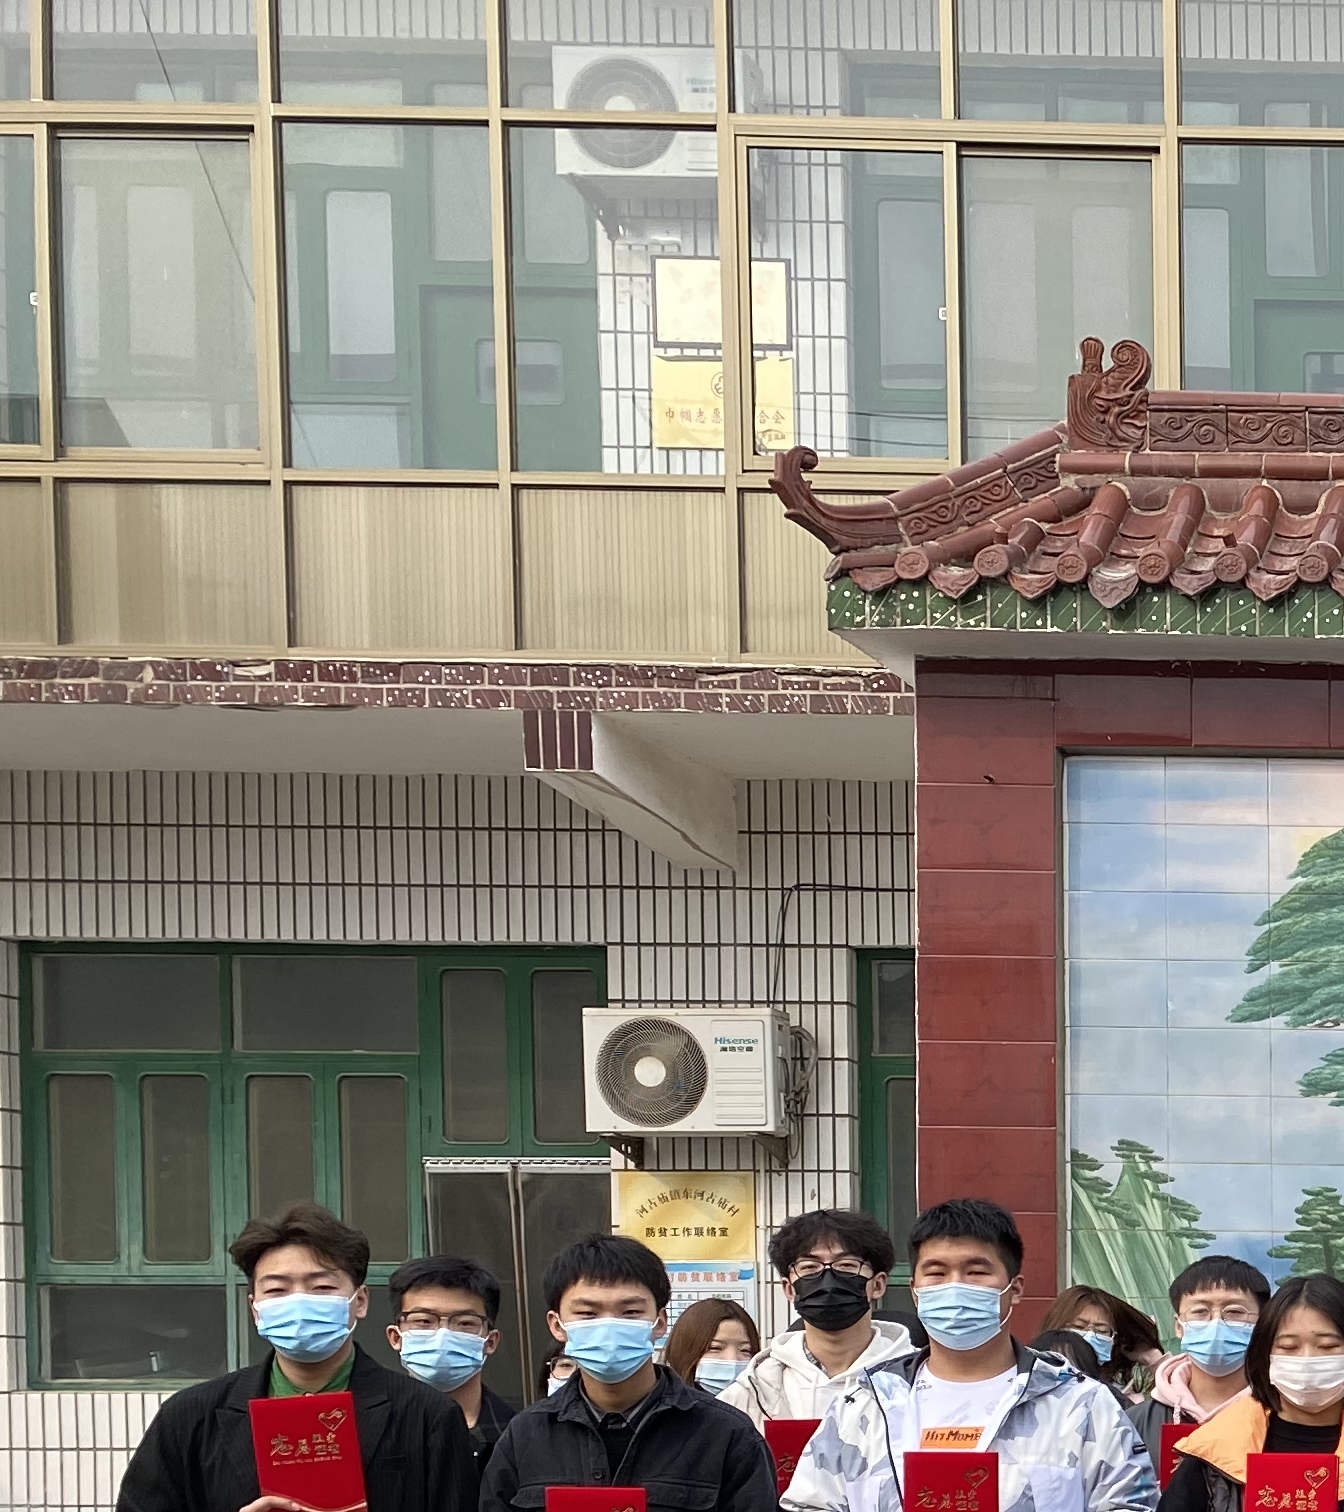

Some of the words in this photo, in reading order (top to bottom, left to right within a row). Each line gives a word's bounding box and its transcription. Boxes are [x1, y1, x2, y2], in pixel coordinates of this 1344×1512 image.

[714, 1036, 759, 1045] Hisense
[645, 1226, 729, 1238] 防贫工作联络室
